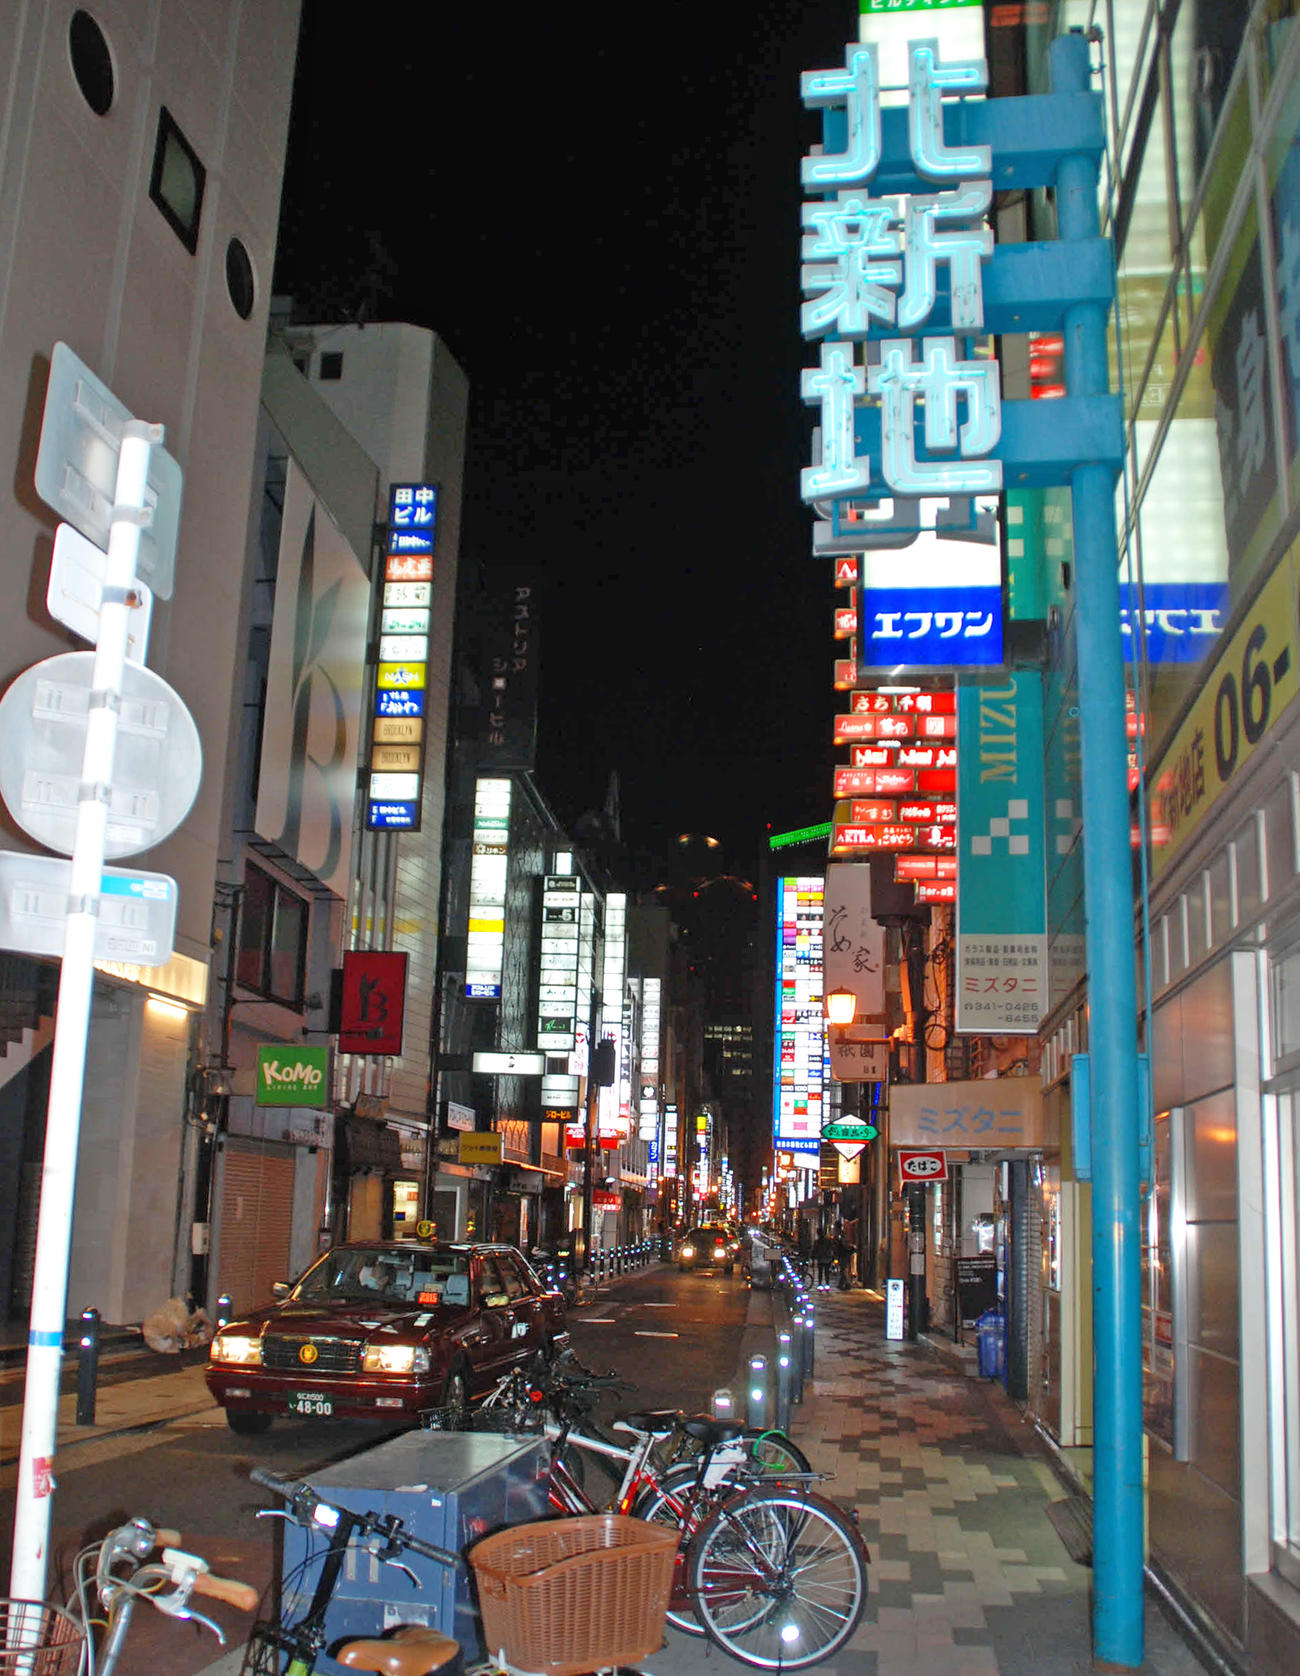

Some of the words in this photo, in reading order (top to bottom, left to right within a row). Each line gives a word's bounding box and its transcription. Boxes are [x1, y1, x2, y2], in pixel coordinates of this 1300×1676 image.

[801, 37, 1002, 498] 北新地
[395, 487, 434, 505] 田中
[394, 506, 432, 523] ビル
[871, 610, 993, 638] エフワン
[964, 977, 1038, 993] ミズタニ
[918, 1106, 1024, 1135] ミズタニ
[907, 1159, 938, 1173] たばこ
[296, 1400, 332, 1416] 48-00
